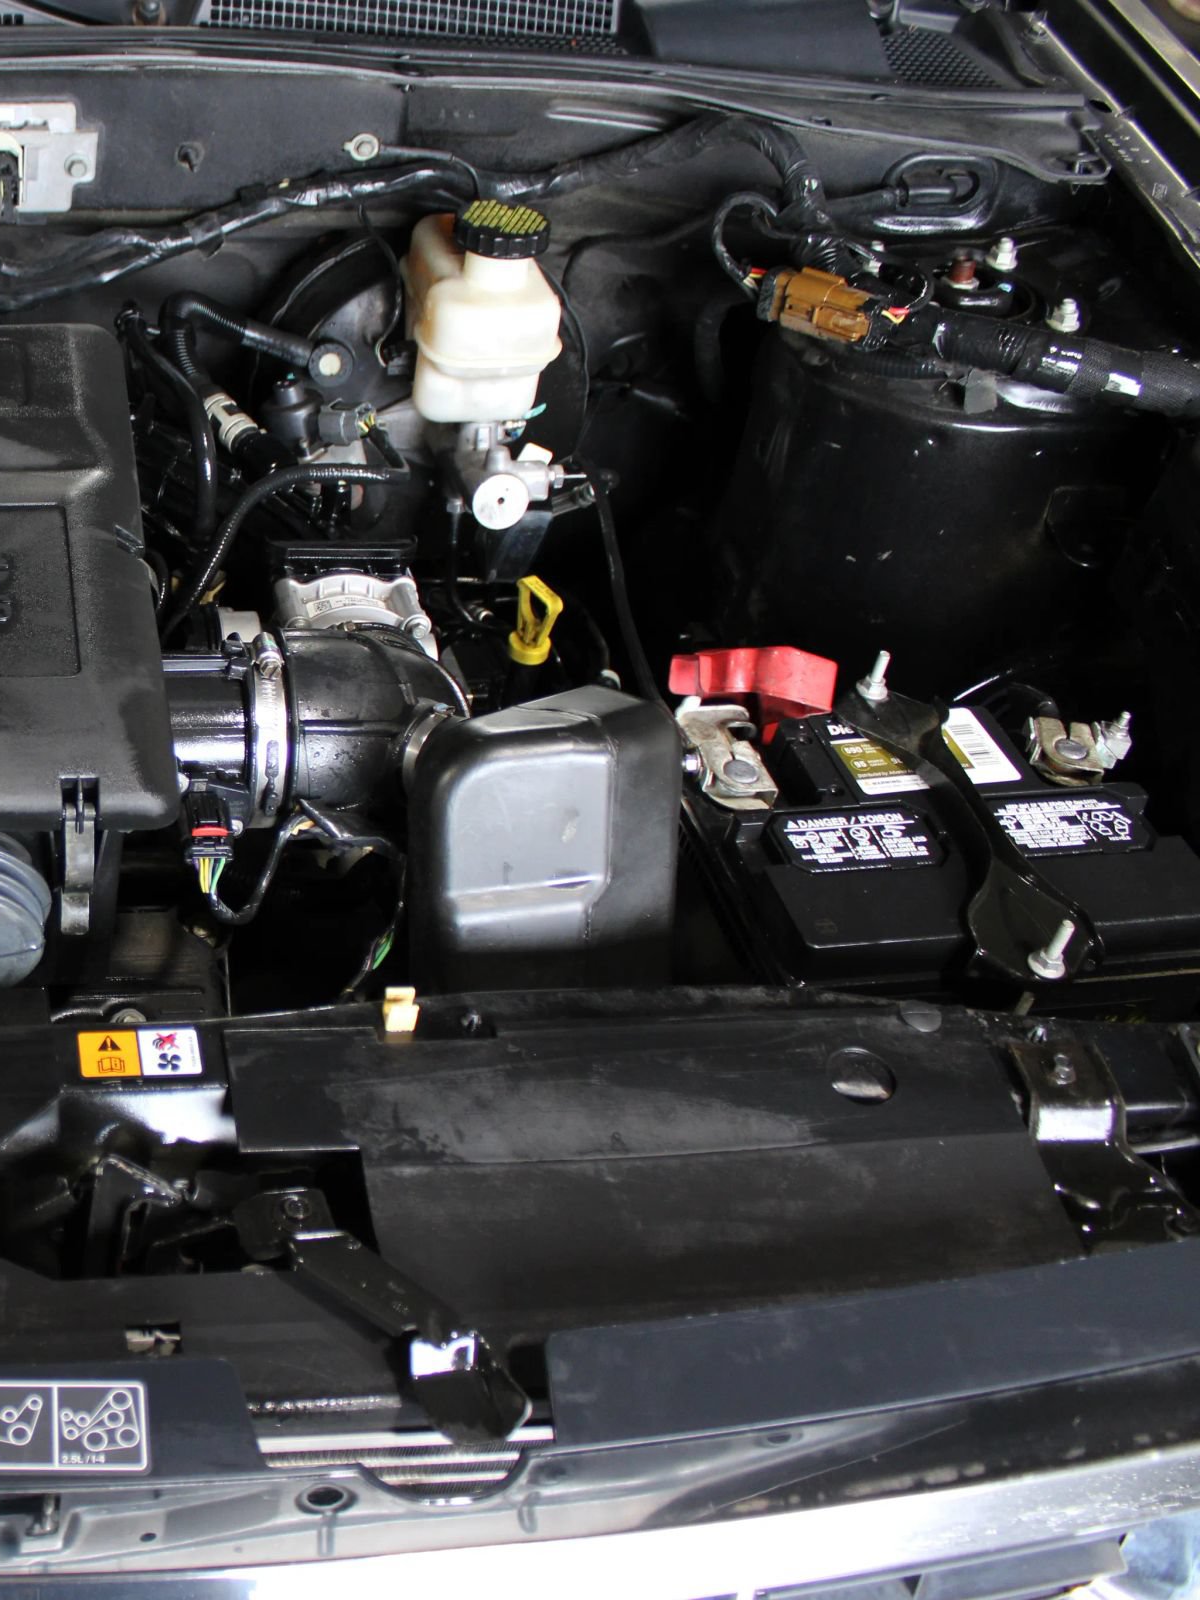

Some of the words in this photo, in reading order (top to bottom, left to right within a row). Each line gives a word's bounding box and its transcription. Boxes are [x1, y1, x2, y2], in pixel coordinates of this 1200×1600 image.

[796, 817, 848, 829] DANGER
[860, 813, 904, 825] POISON
[62, 1454, 84, 1464] 2.5L
